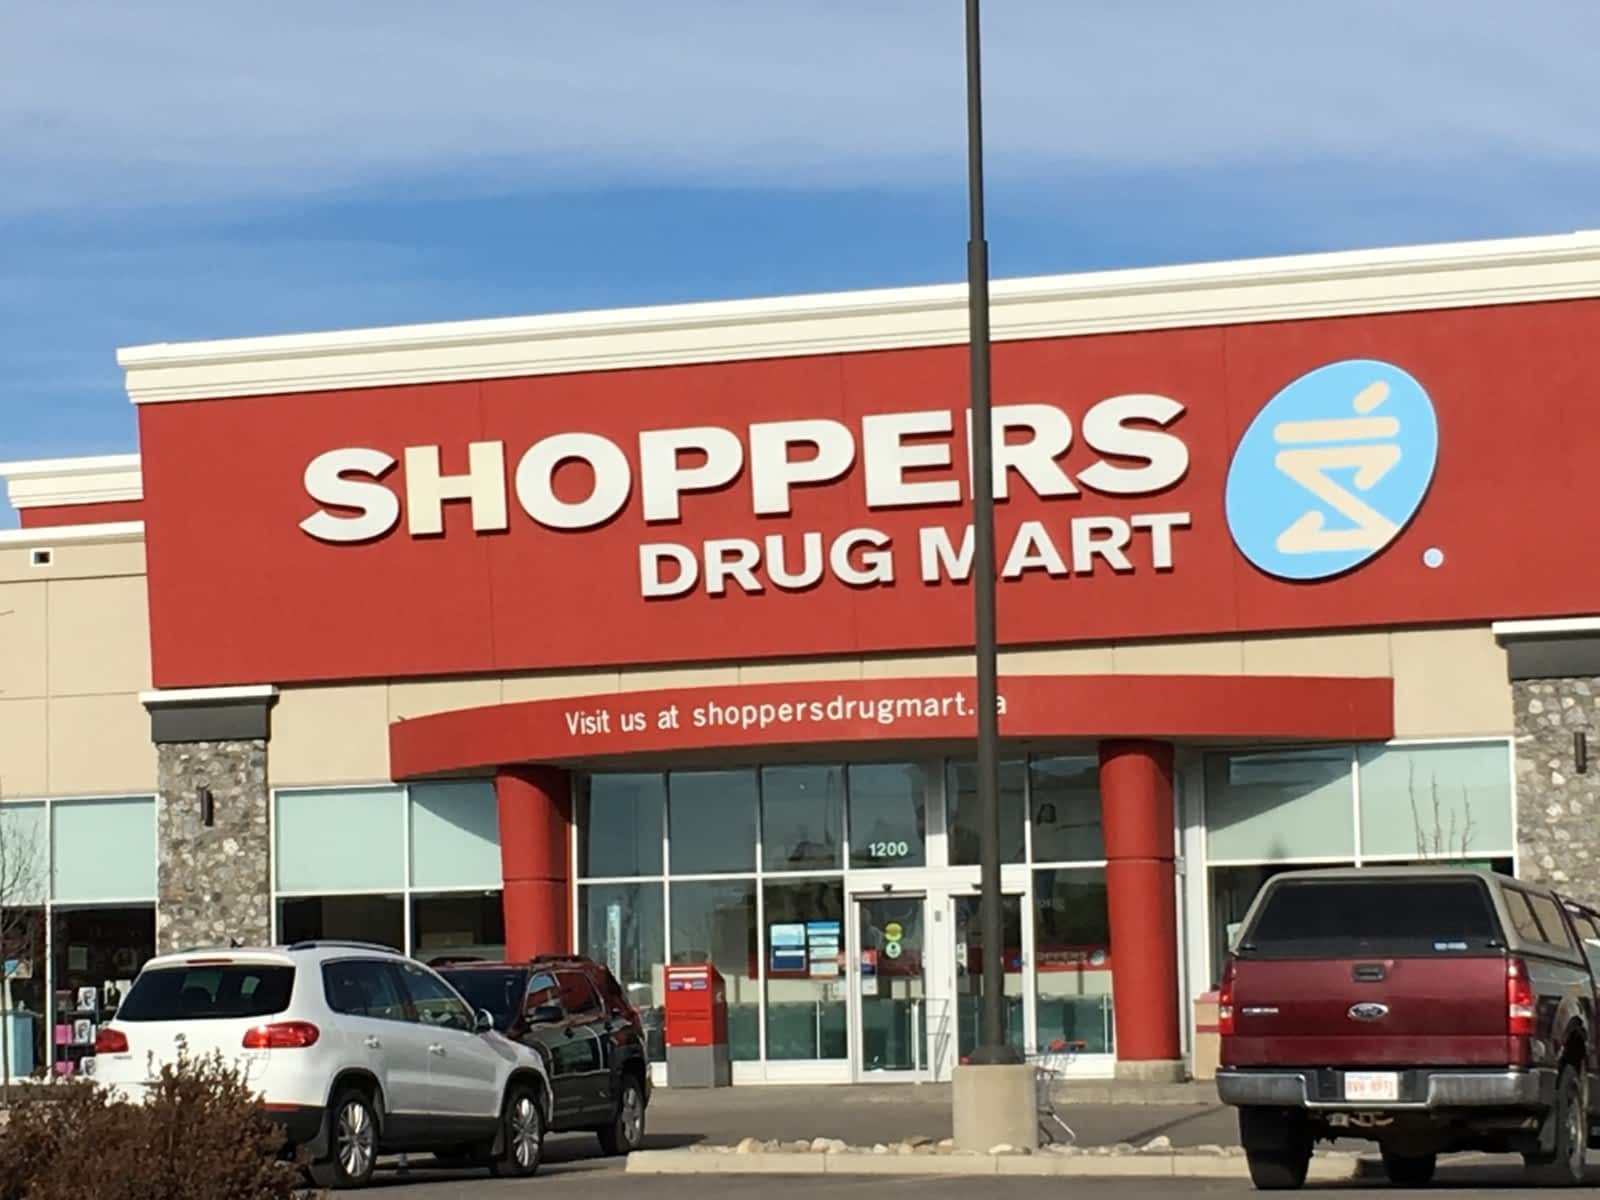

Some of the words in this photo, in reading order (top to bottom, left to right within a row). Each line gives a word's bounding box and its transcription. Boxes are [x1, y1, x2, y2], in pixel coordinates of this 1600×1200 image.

[299, 394, 1190, 543] SHOPPERS
[639, 527, 894, 598] DRUG
[919, 512, 1192, 583] MART
[565, 710, 611, 736] Visit
[620, 711, 647, 732] us
[657, 705, 680, 729] at
[692, 691, 1007, 729] shoppersdrugmart.a
[868, 841, 909, 857] 1200
